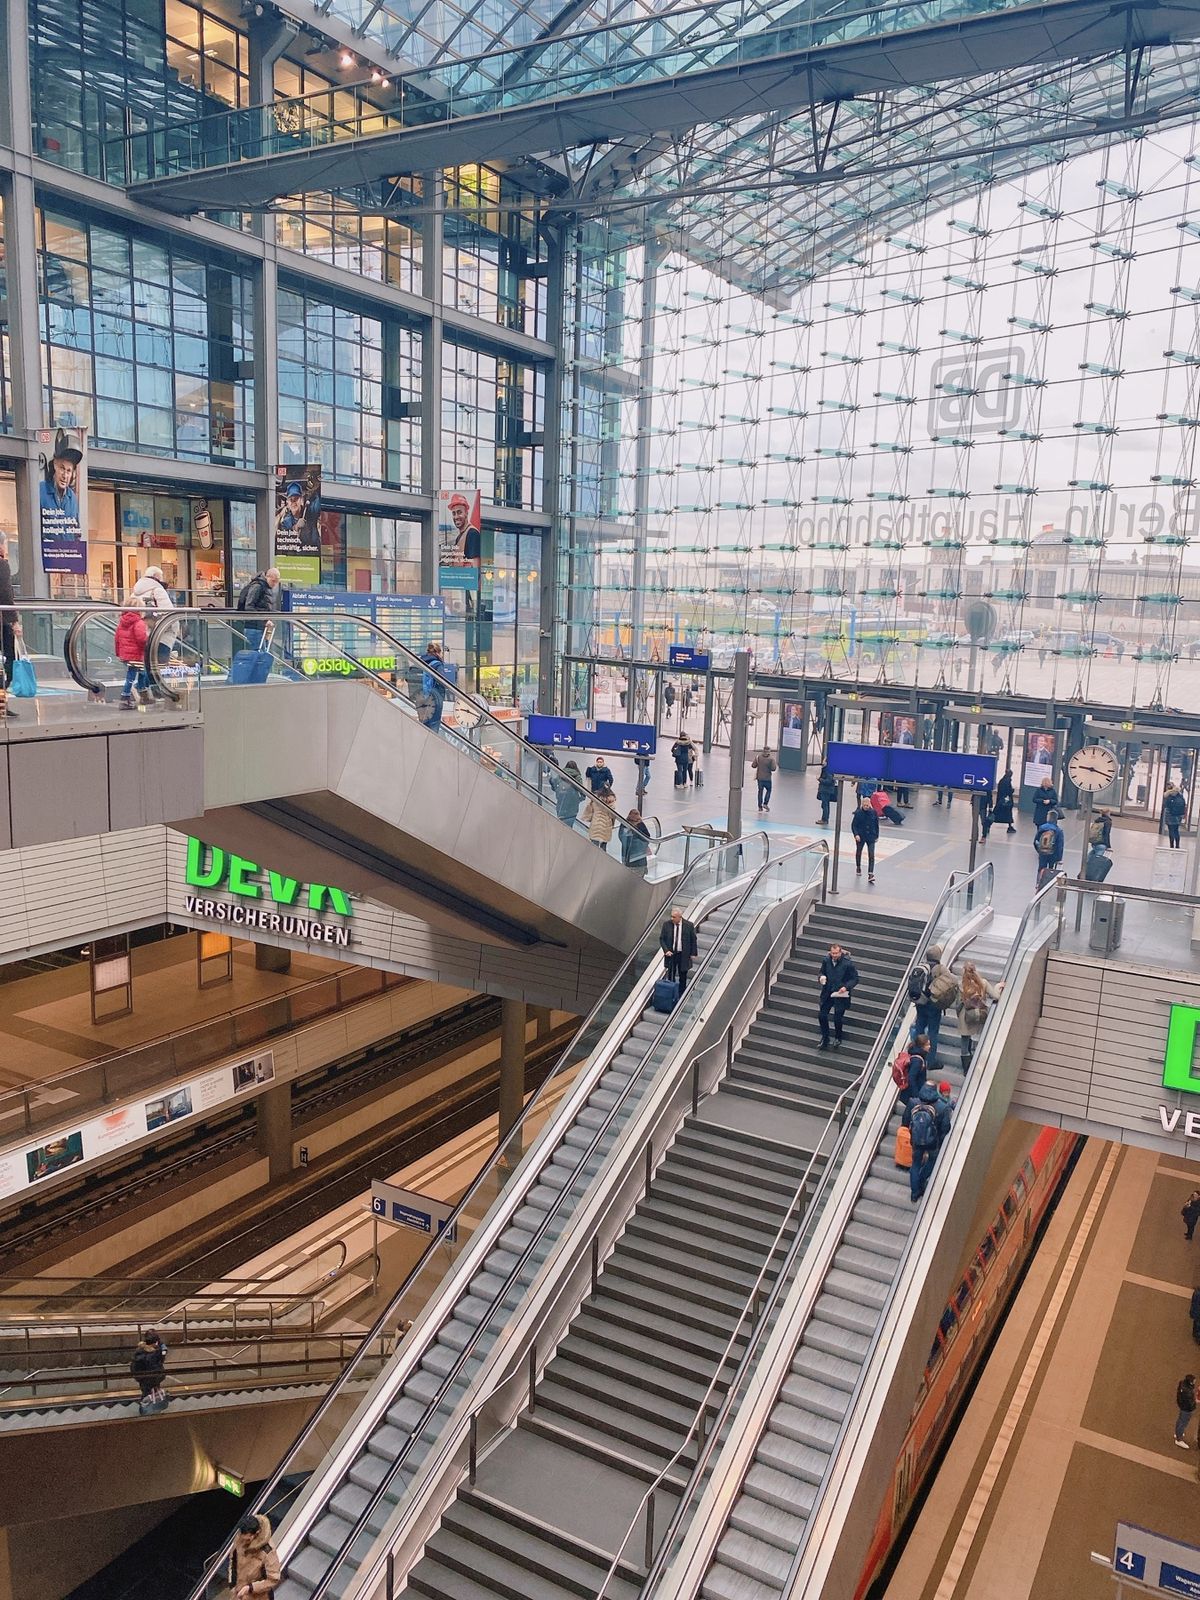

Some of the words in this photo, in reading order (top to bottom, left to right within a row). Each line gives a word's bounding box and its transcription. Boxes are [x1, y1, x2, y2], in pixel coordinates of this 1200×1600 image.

[585, 722, 592, 731] U
[184, 896, 350, 947] VERSICHERUNGEN
[373, 1197, 381, 1211] 6
[1120, 1551, 1134, 1570] 4
